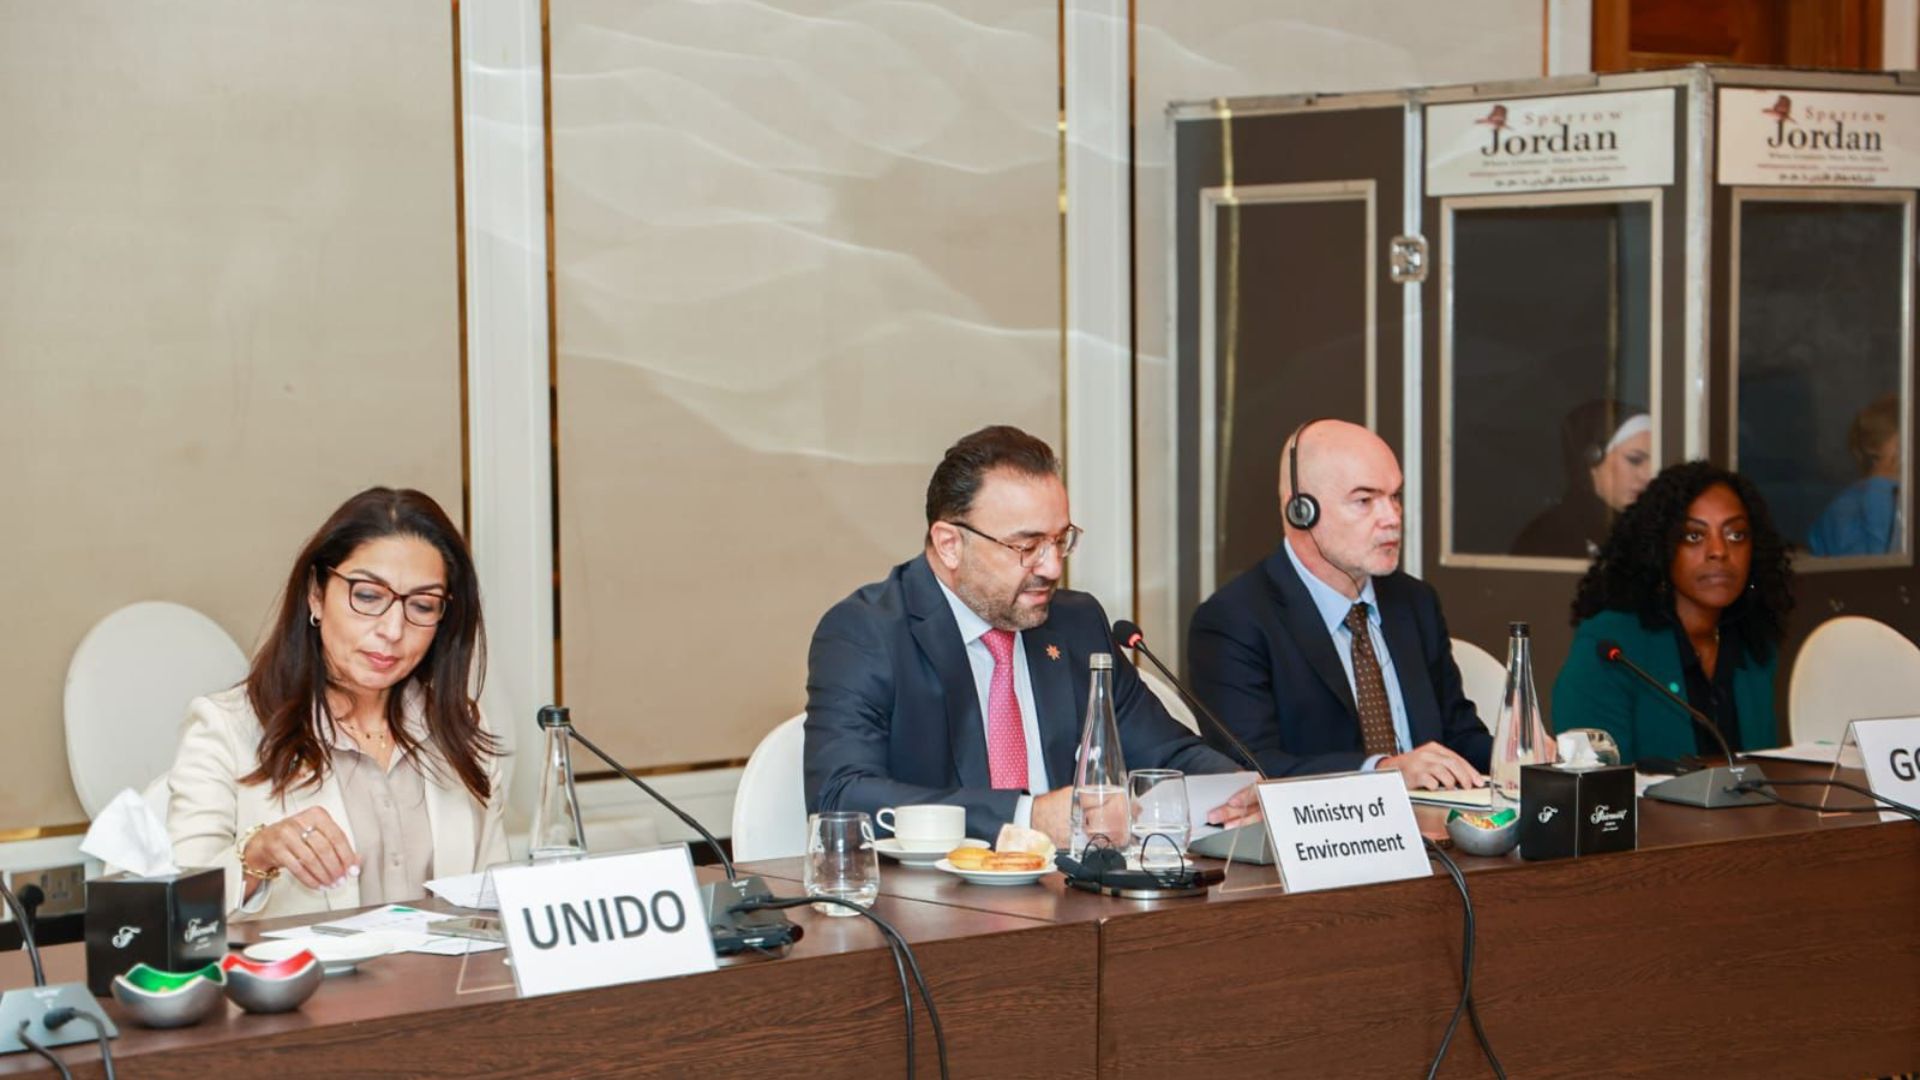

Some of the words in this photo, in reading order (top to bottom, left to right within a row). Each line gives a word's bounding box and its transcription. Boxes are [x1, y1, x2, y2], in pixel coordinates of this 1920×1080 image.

[1523, 110, 1623, 127] Sparrow
[1805, 106, 1886, 122] Sparrow
[1481, 123, 1618, 157] Jordan
[1767, 121, 1882, 152] Jordan
[1293, 803, 1363, 826] Ministry
[1369, 797, 1386, 817] of
[1295, 833, 1406, 861] Environment
[522, 890, 686, 950] UNIDO
